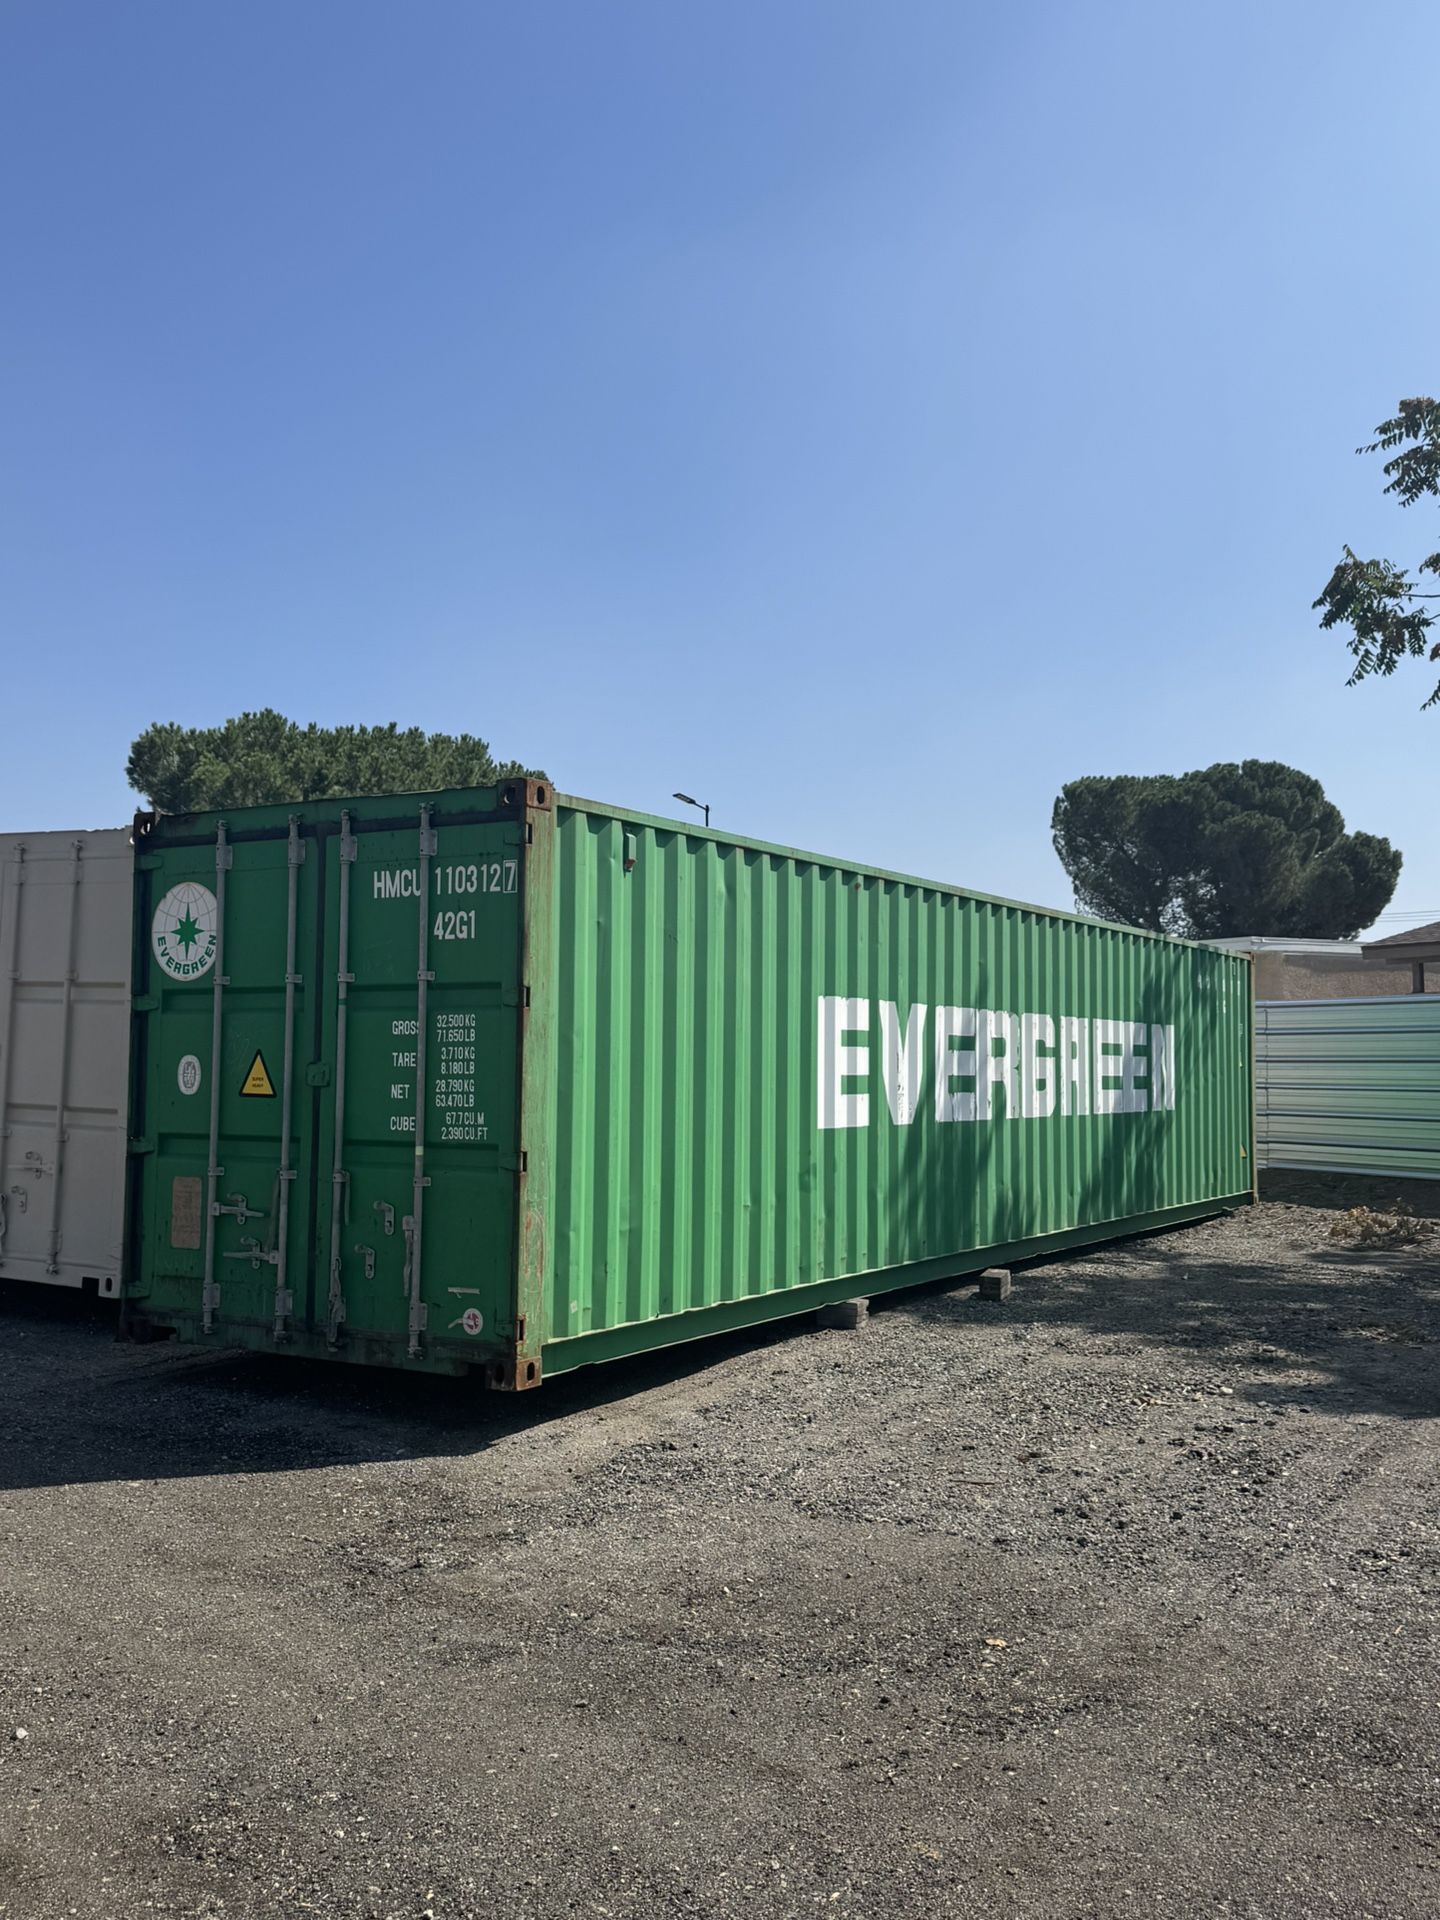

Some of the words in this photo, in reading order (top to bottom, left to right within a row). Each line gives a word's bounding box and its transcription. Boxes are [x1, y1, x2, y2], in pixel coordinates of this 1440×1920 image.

[374, 869, 421, 899] HMCU
[433, 910, 476, 940] 42G1
[157, 934, 217, 975] EVERGREEN
[465, 1014, 476, 1027] KG
[436, 1029, 464, 1042] 71.650
[464, 1028, 476, 1041] LB
[392, 1052, 416, 1067] TARE
[441, 1047, 464, 1059] 3.710
[464, 1047, 475, 1059] KG
[817, 995, 1176, 1130] EVERGREEN
[440, 1062, 464, 1074] 8.180
[464, 1061, 475, 1074] LB
[391, 1084, 410, 1099] NET
[435, 1080, 463, 1092] 28.790
[463, 1079, 475, 1092] KG
[435, 1095, 463, 1107] 63.470
[463, 1094, 474, 1107] LB
[390, 1116, 416, 1131] CUBE
[445, 1112, 463, 1125] 67.7
[441, 1127, 464, 1140] 2.390
